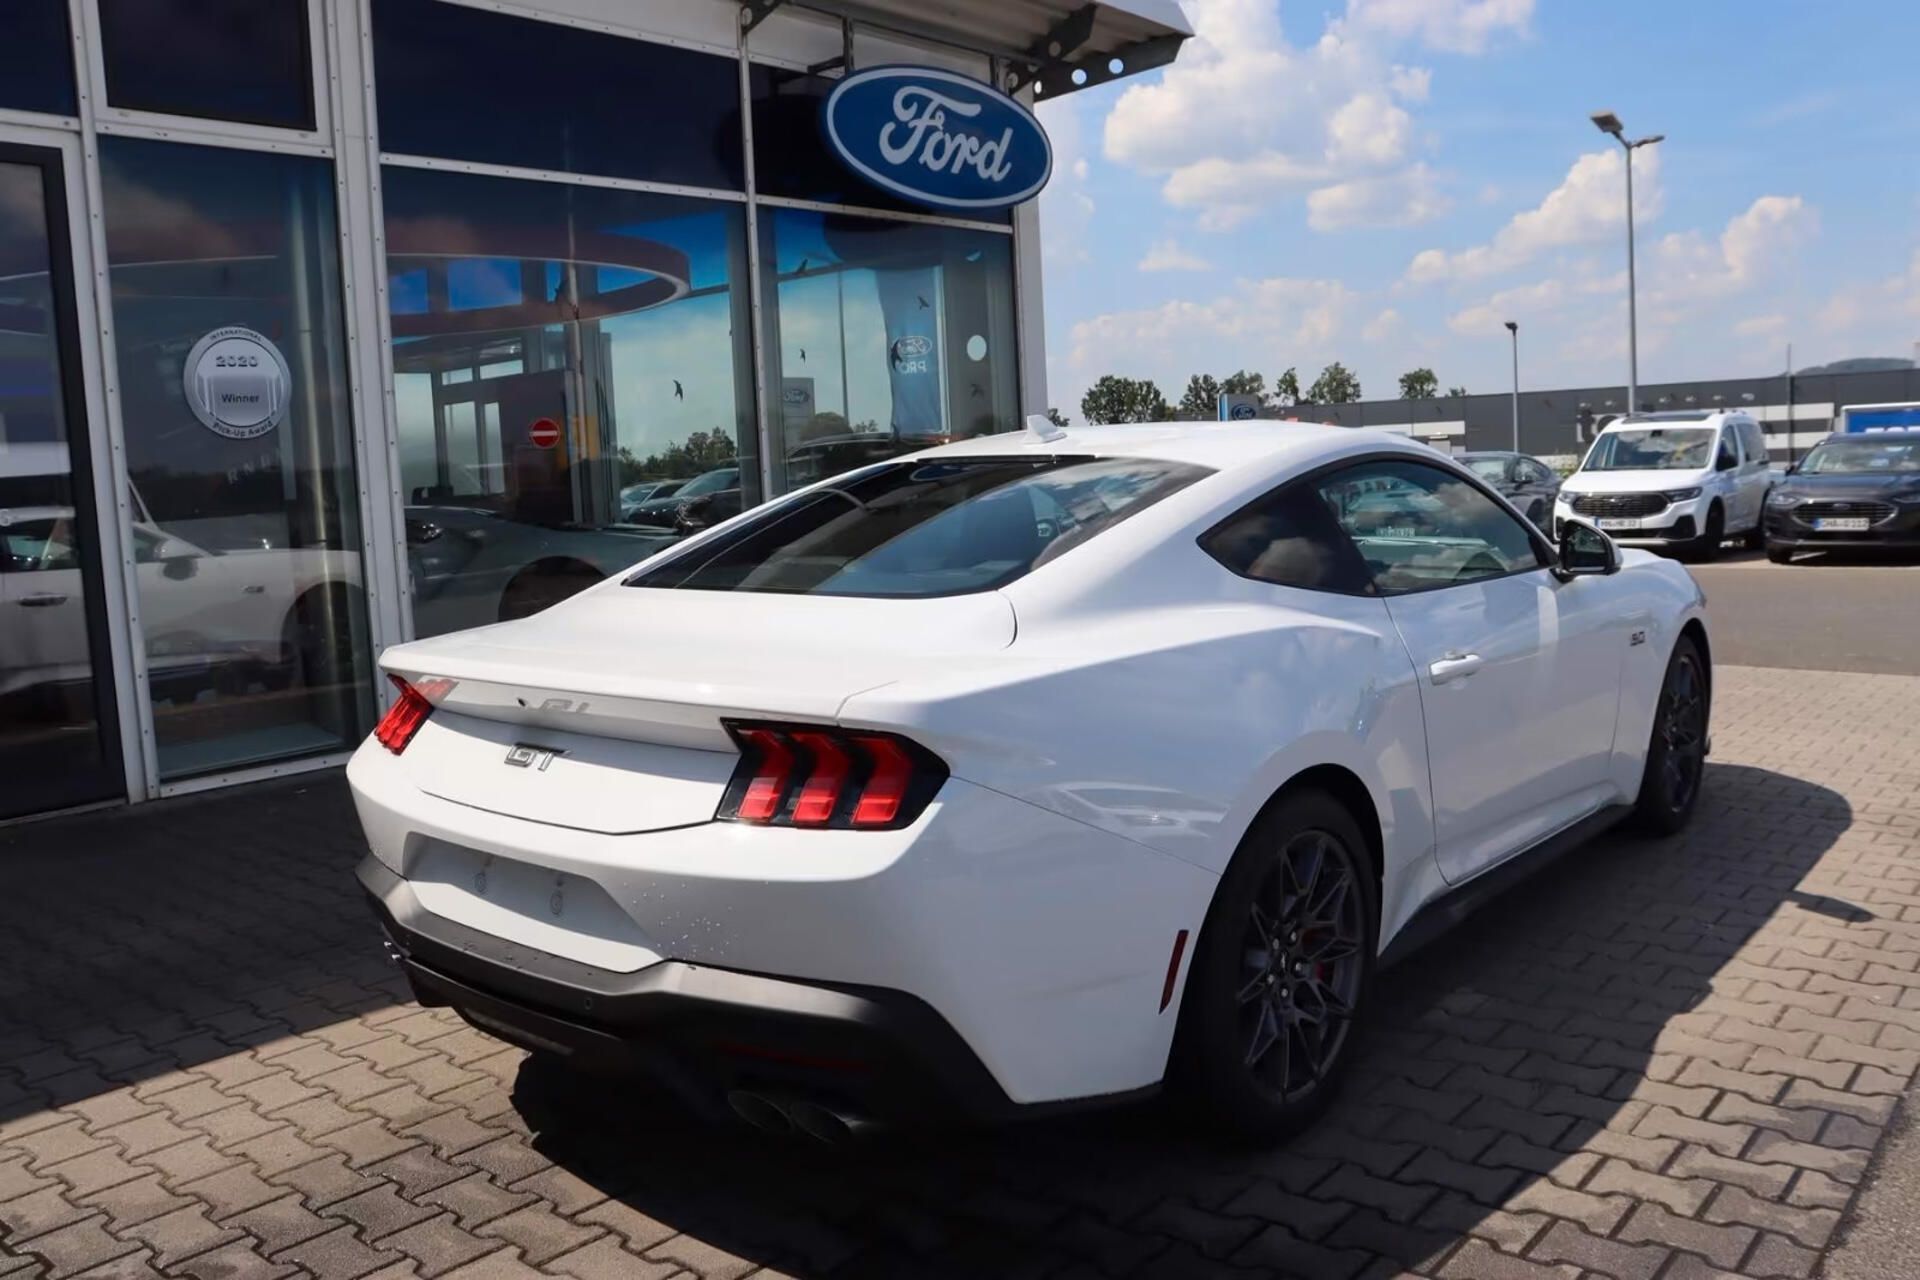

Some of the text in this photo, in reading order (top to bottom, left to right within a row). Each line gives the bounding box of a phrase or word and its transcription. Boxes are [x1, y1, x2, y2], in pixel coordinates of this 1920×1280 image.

[879, 85, 1012, 182] Ford
[209, 328, 262, 341] INTERNATIONAL
[216, 355, 259, 368] 2020
[221, 394, 260, 403] Winner
[212, 420, 273, 437] Pick-Up Award
[504, 742, 571, 772] GT
